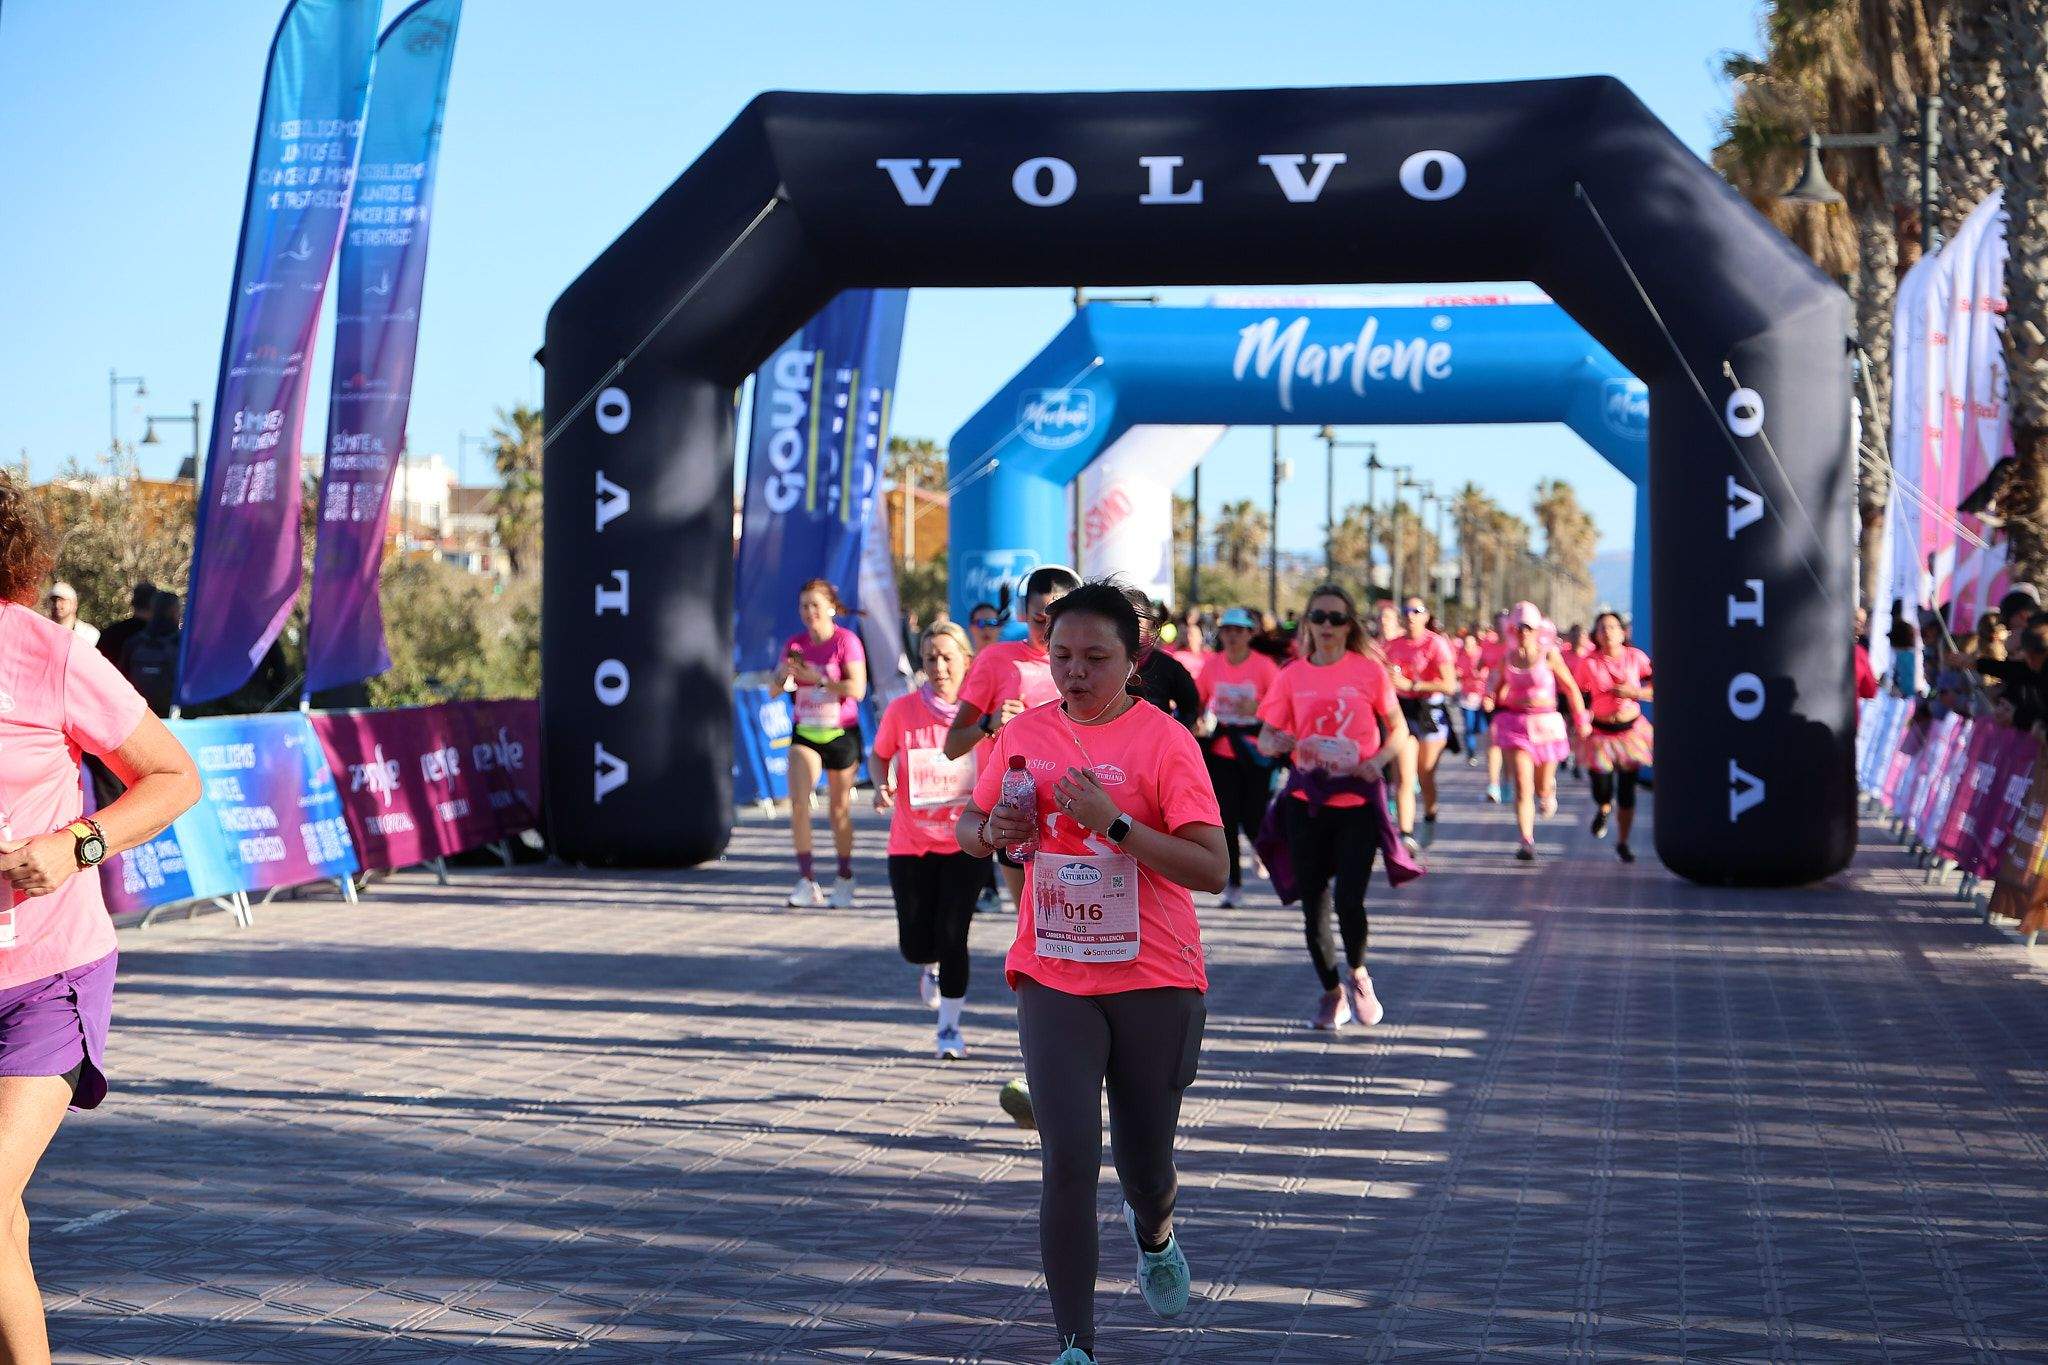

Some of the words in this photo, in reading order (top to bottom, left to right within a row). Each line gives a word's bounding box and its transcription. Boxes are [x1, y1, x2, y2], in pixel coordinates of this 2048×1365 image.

[876, 150, 1467, 207] VOLVO
[1233, 315, 1453, 413] Marlene
[764, 349, 817, 514] GOYA
[593, 386, 632, 804] VOLVO
[1726, 387, 1767, 824] VOLVO
[1025, 759, 1056, 771] YSHO
[1060, 870, 1099, 881] ASTURIANA
[1063, 903, 1103, 921] 016
[1045, 931, 1065, 940] CARRERA
[1099, 934, 1125, 942] VALENCIA
[1045, 942, 1074, 954] OYSHO
[1092, 947, 1128, 957] Santander
